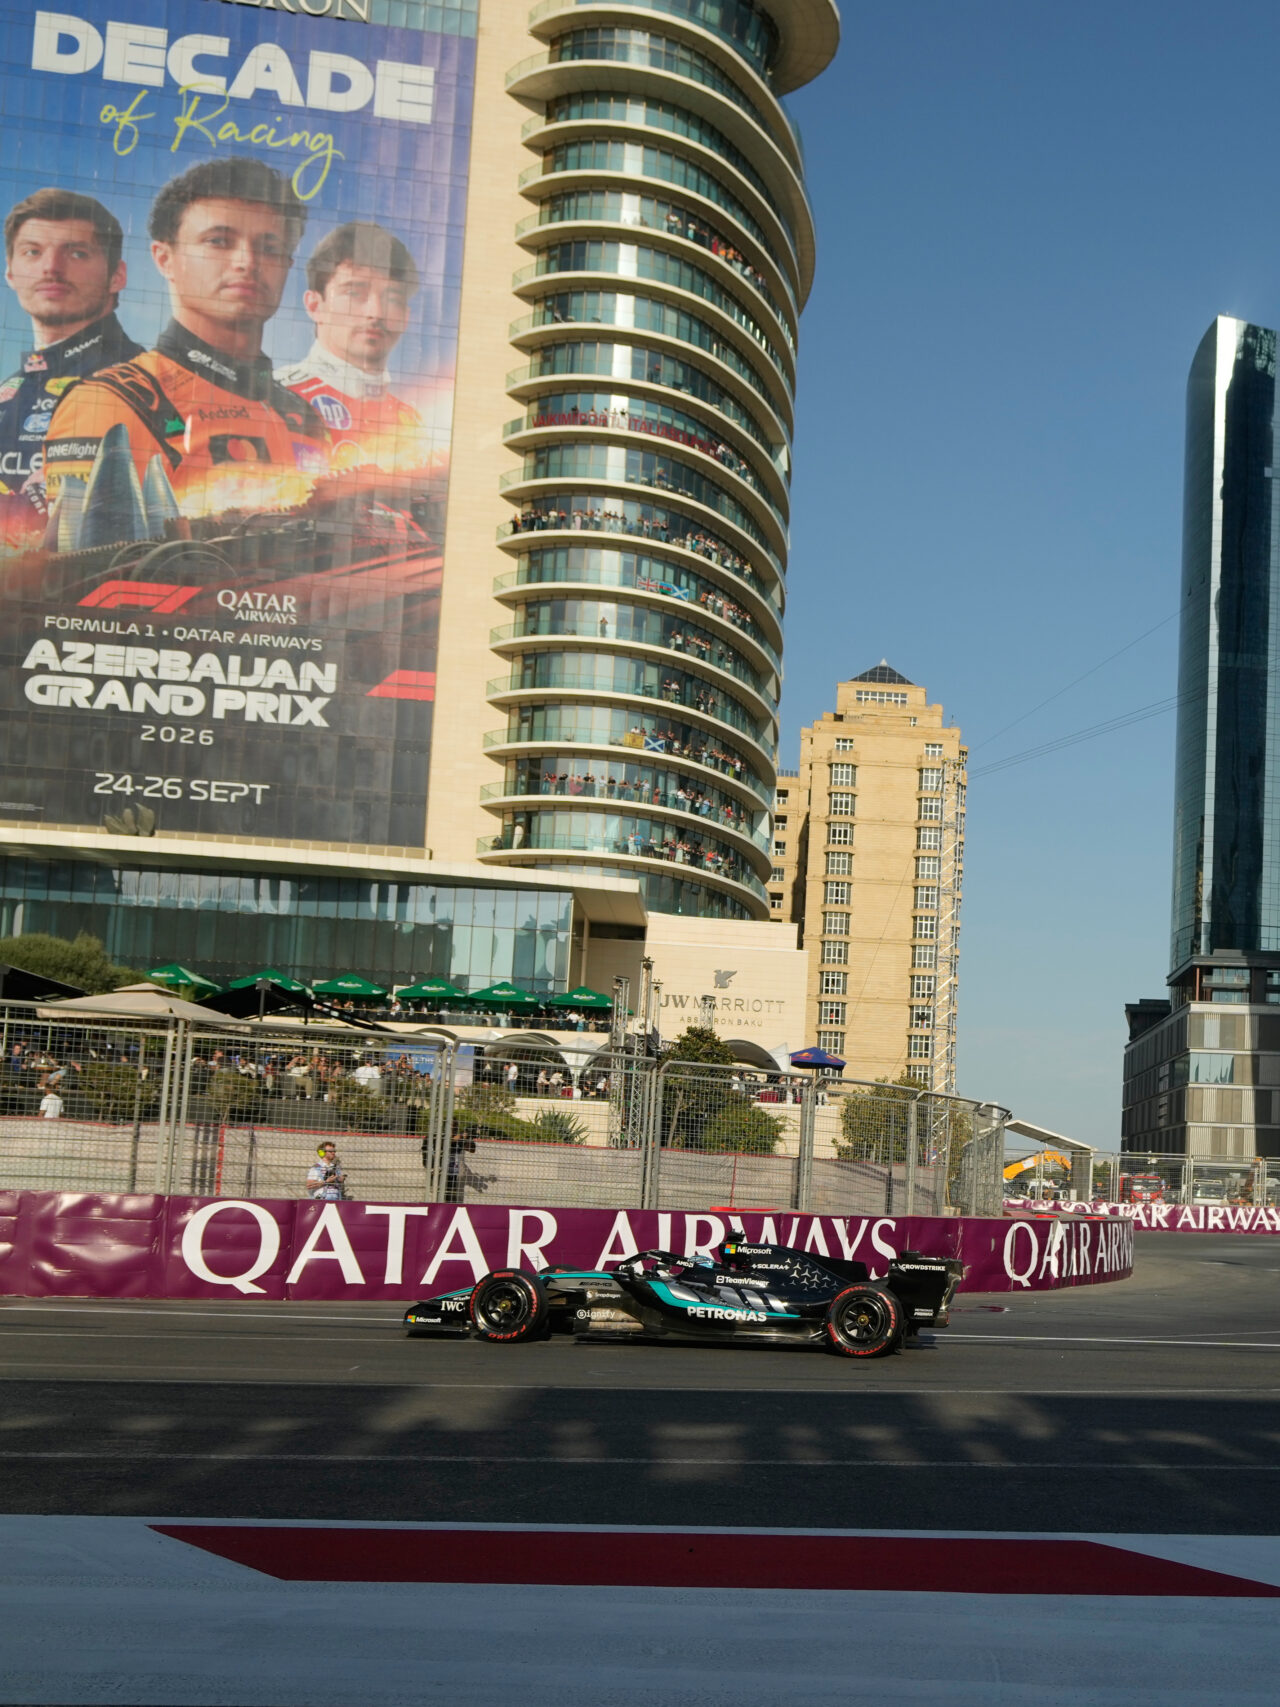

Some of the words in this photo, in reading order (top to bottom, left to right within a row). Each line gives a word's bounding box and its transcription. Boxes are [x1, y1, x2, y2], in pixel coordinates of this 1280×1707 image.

[31, 11, 435, 124] DECADE
[100, 90, 156, 156] of
[171, 82, 345, 200] Racing
[318, 397, 344, 430] hp
[0, 452, 43, 475] CLE
[216, 589, 297, 613] QATAR
[234, 609, 297, 625] AIRWAYS
[44, 615, 139, 636] FORMULA
[144, 624, 156, 637] 1
[174, 626, 236, 644] QATAR
[239, 631, 323, 651] AIRWAYS
[22, 638, 338, 694] AZERBAIJAN
[24, 674, 206, 716] GRAND
[212, 688, 330, 728] PRIX
[140, 725, 215, 746] 2026
[93, 772, 182, 800] 24-26
[189, 779, 270, 805] SEPT
[660, 994, 690, 1009] JW
[679, 1016, 734, 1026] ABSRON
[736, 1018, 763, 1028] BAKU
[182, 1200, 558, 1294] QATAR
[737, 1246, 772, 1255] Microsoft
[901, 1263, 946, 1271] CROWDSTRIKE
[725, 1276, 770, 1288] TeamViewer
[441, 1300, 464, 1312] IWC
[577, 1309, 616, 1321] signify
[687, 1305, 767, 1322] PETRONAS
[415, 1316, 442, 1324] Microsoft
